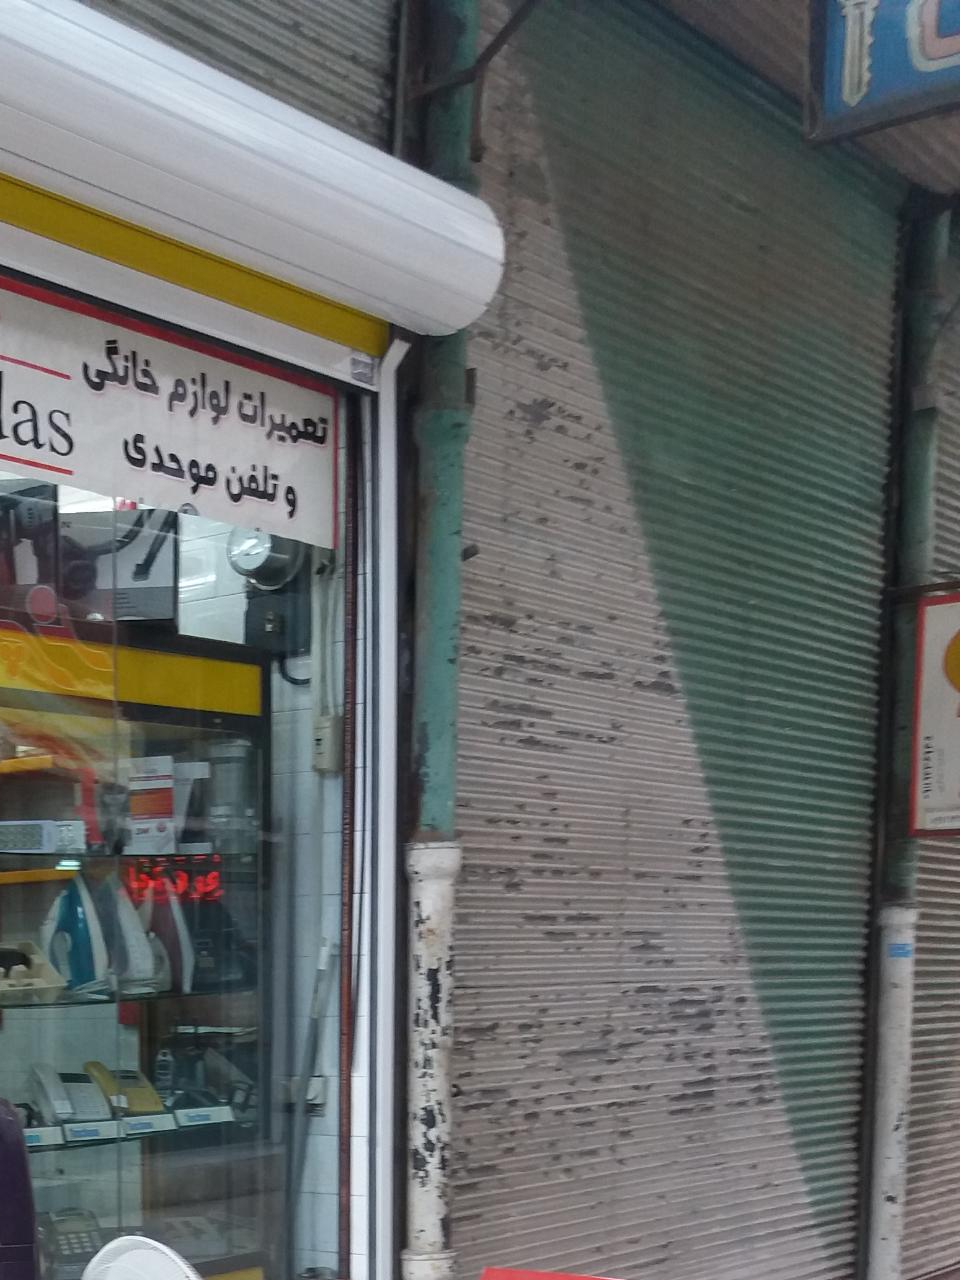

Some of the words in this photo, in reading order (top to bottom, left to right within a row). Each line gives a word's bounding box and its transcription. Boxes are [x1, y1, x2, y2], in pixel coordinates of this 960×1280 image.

[82, 340, 160, 396] خانگی
[168, 372, 231, 426] لوازم
[239, 392, 328, 445] تعمیرات
[124, 432, 217, 494] موحدی
[225, 464, 280, 504] تلفن
[284, 483, 298, 518] و
